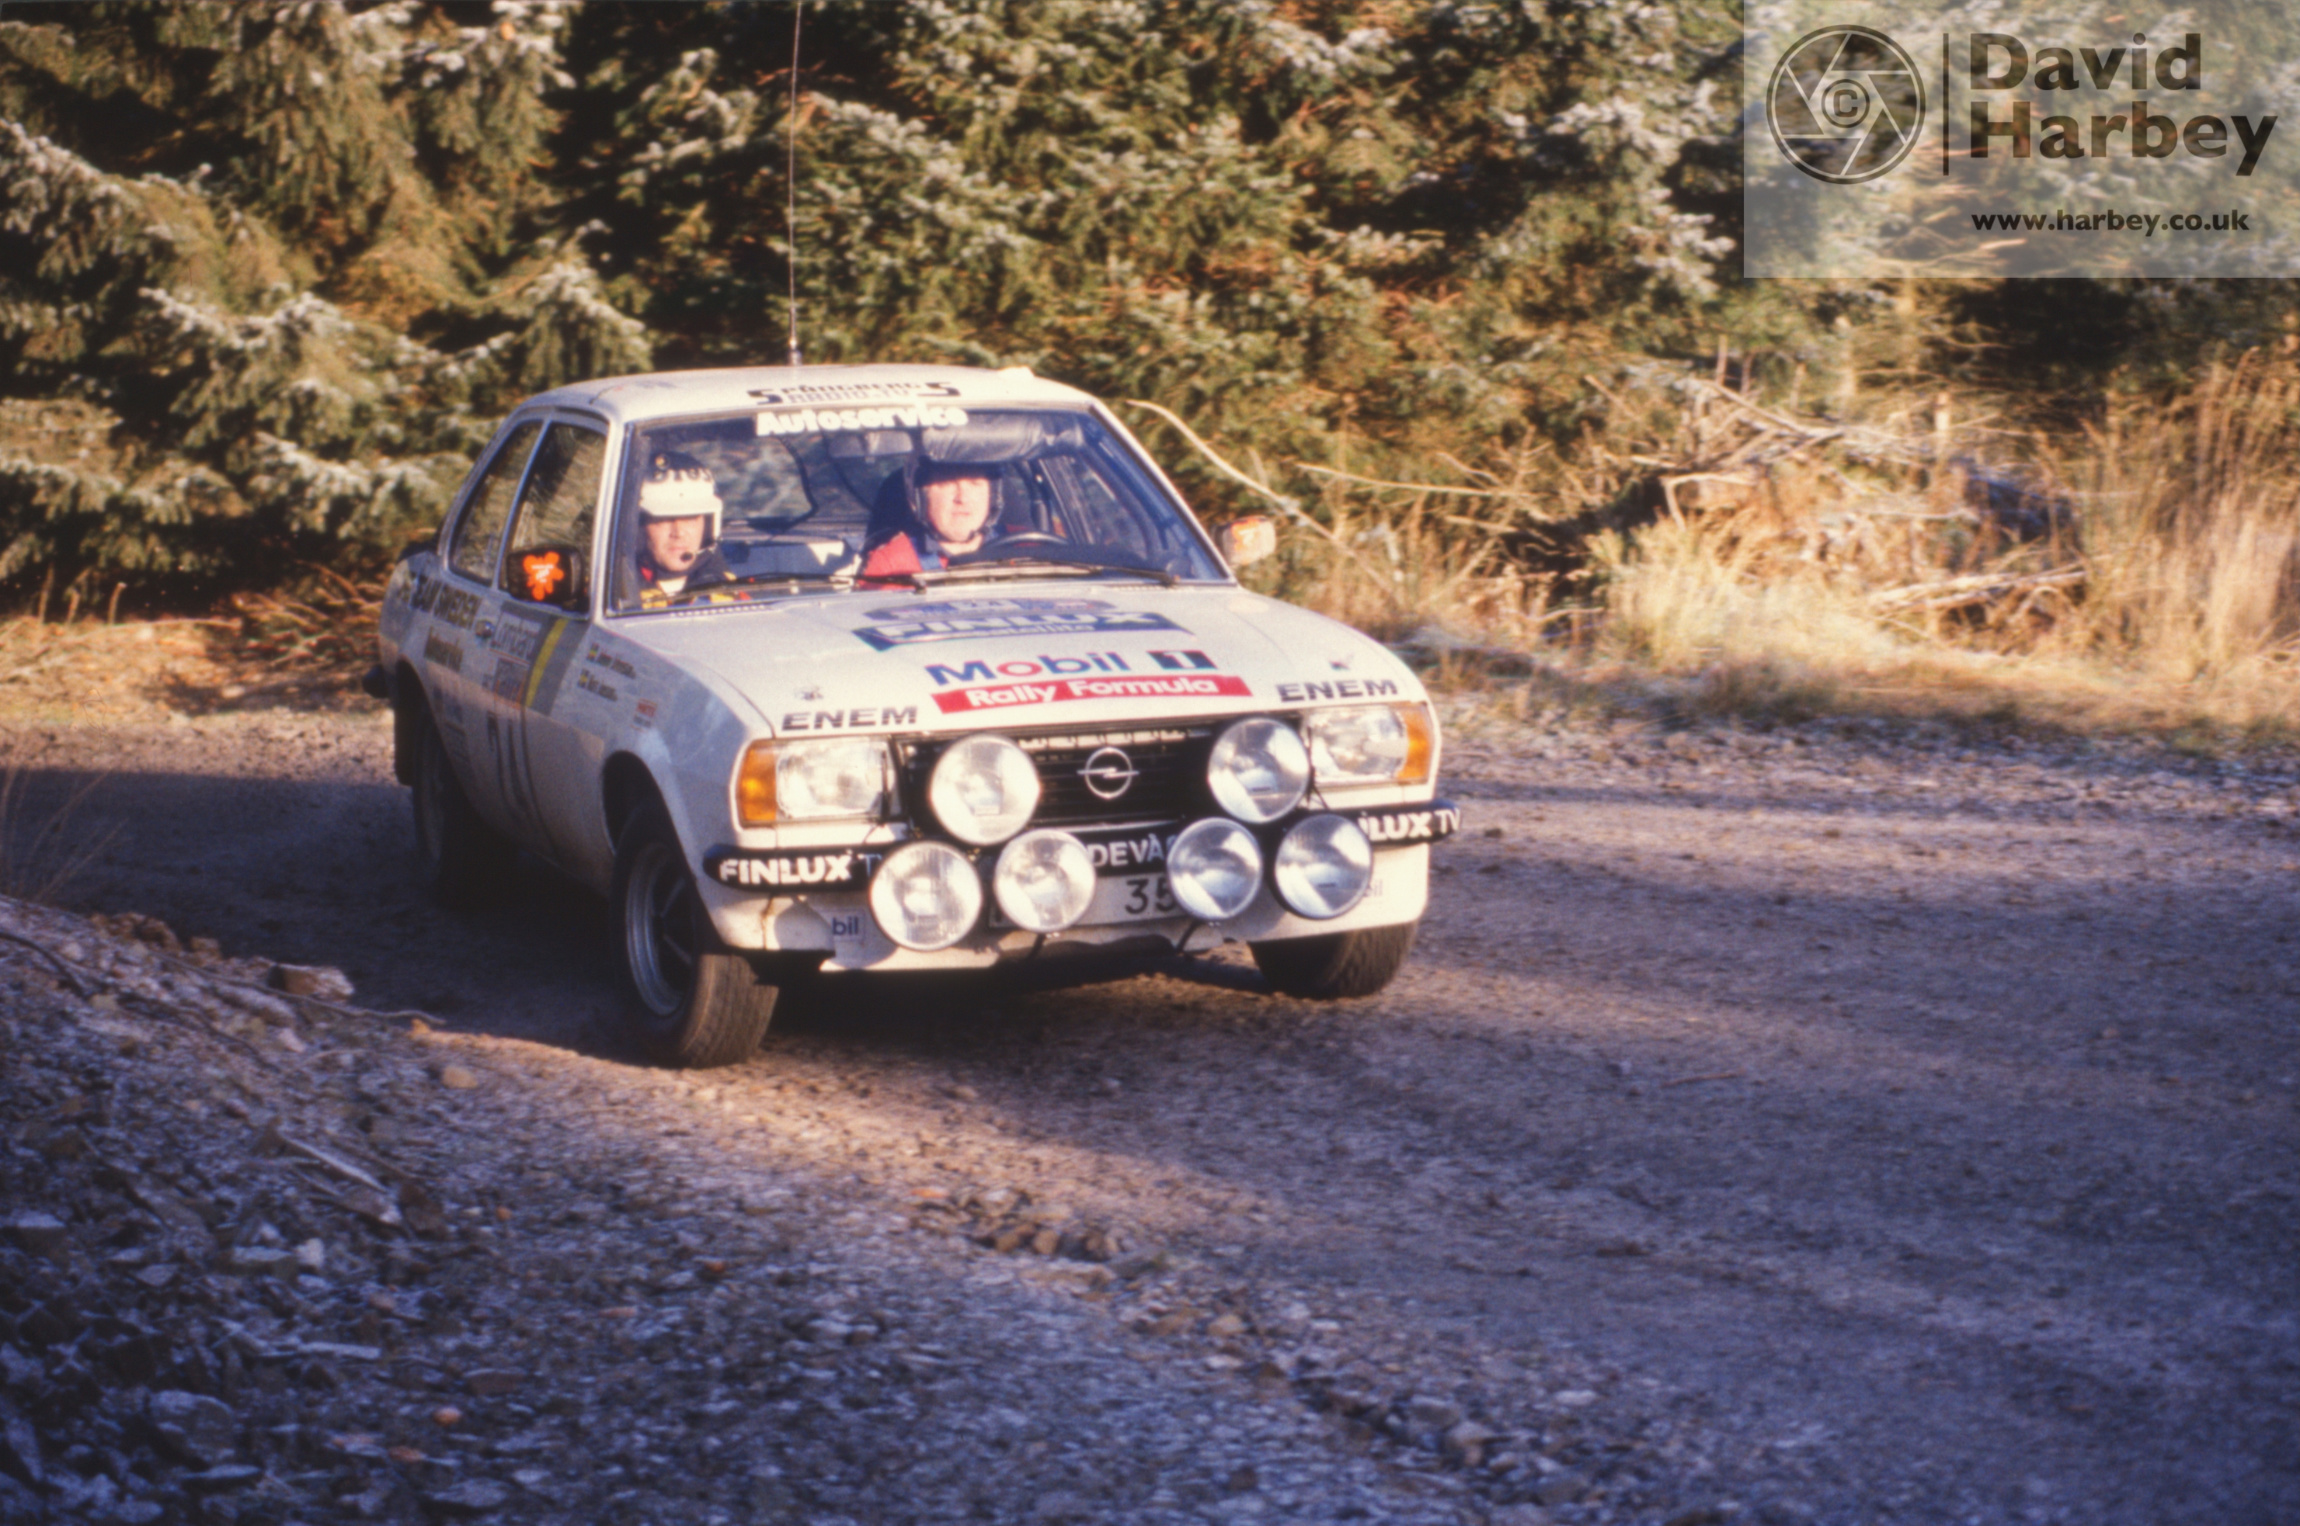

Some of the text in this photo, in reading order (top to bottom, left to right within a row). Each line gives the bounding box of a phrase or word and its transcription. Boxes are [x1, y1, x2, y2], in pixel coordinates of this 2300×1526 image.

[875, 612, 1158, 637] FINLUX
[924, 652, 1131, 686] Mobil
[964, 676, 1219, 708] Rally Formula
[1275, 679, 1399, 703] ENEM
[781, 706, 918, 732] ENEM
[718, 853, 854, 886] FINLUX
